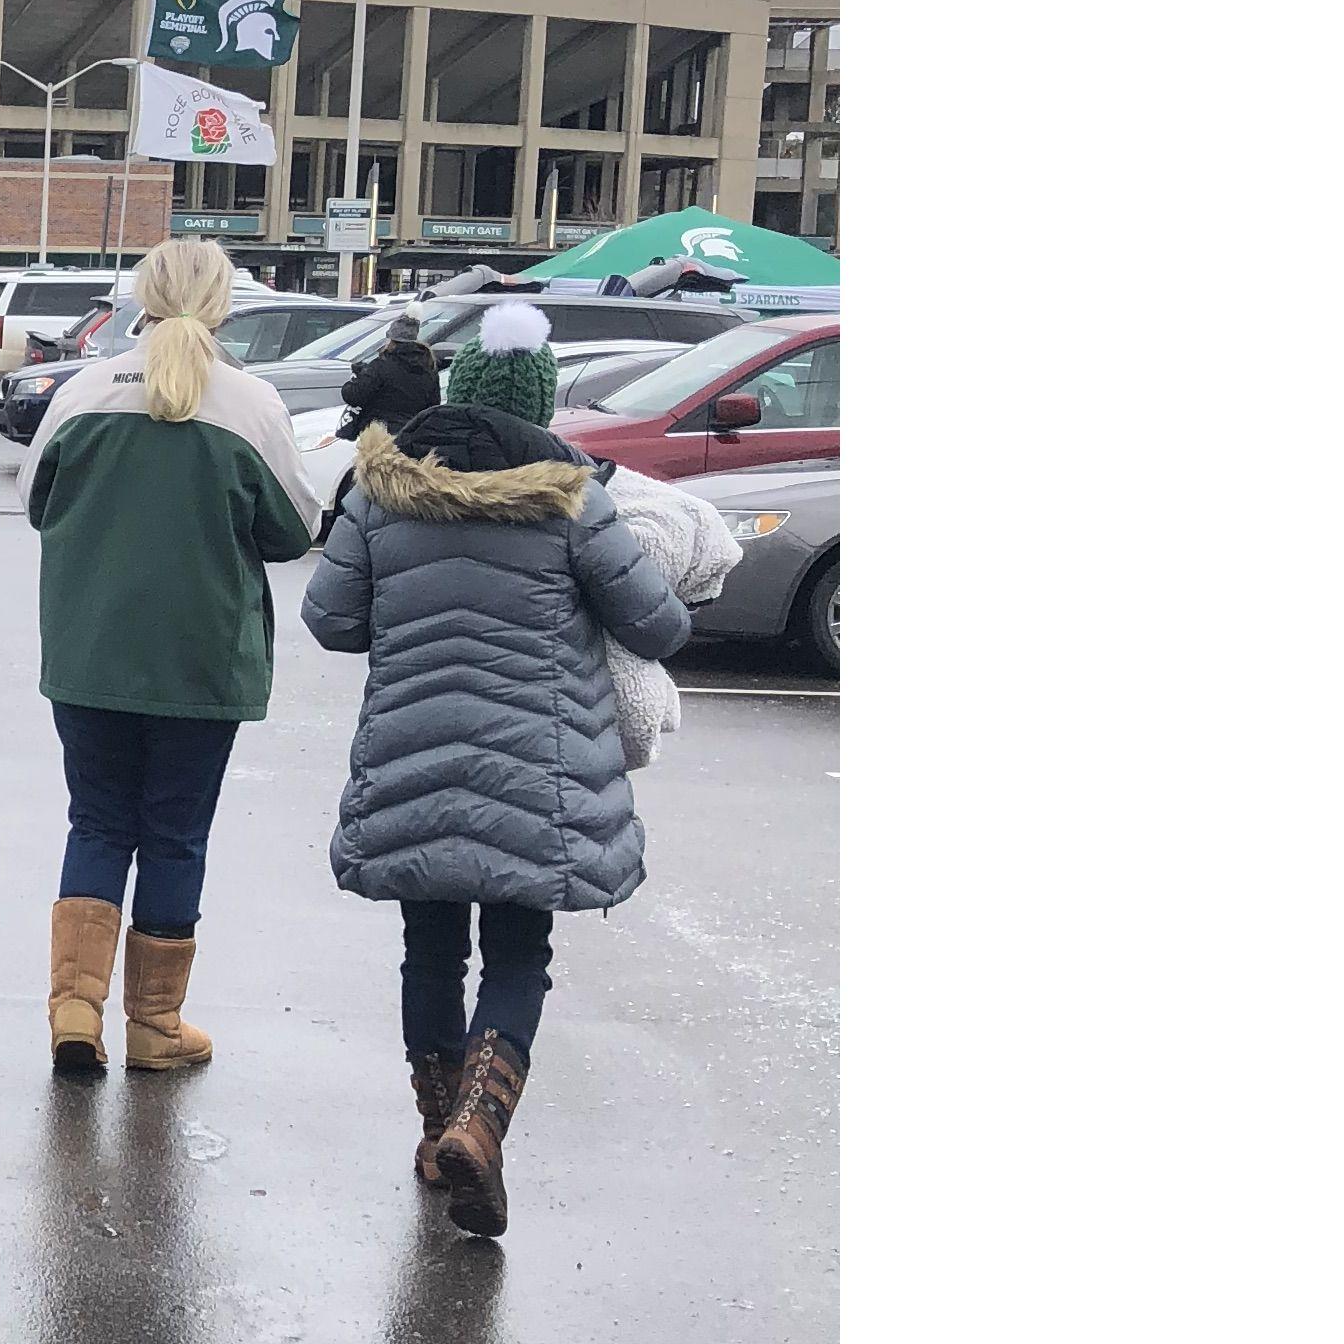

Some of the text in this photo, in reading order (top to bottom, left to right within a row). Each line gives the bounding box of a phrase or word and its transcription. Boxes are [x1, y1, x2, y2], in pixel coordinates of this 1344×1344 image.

[165, 11, 205, 25] PLAYOFF
[159, 19, 208, 34] SEMIFINAL
[165, 94, 188, 139] ROSE
[184, 218, 229, 229] GATE B
[432, 224, 503, 236] STUDENT GATE
[740, 294, 801, 306] SPARTANS
[112, 372, 146, 384] MICHI
